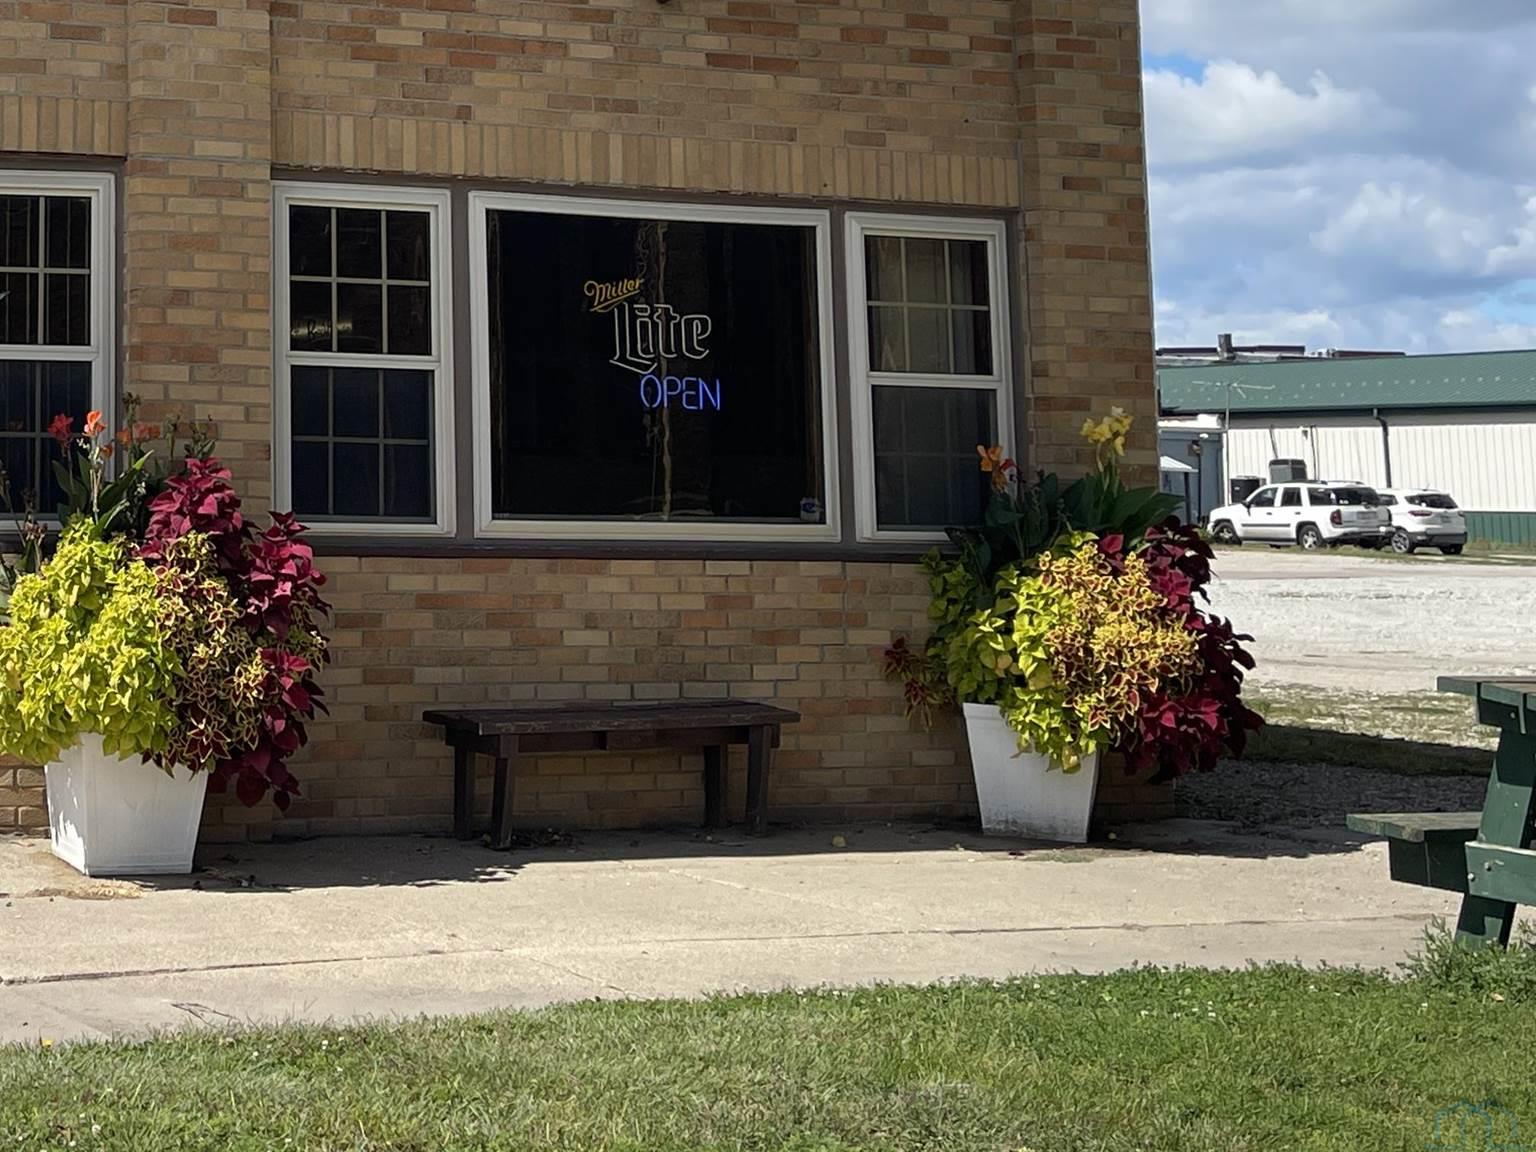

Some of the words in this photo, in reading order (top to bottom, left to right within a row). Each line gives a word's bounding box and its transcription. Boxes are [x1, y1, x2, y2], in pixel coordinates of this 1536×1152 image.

[583, 278, 645, 313] Miller
[609, 301, 712, 374] Lite
[639, 373, 721, 411] OPEN
